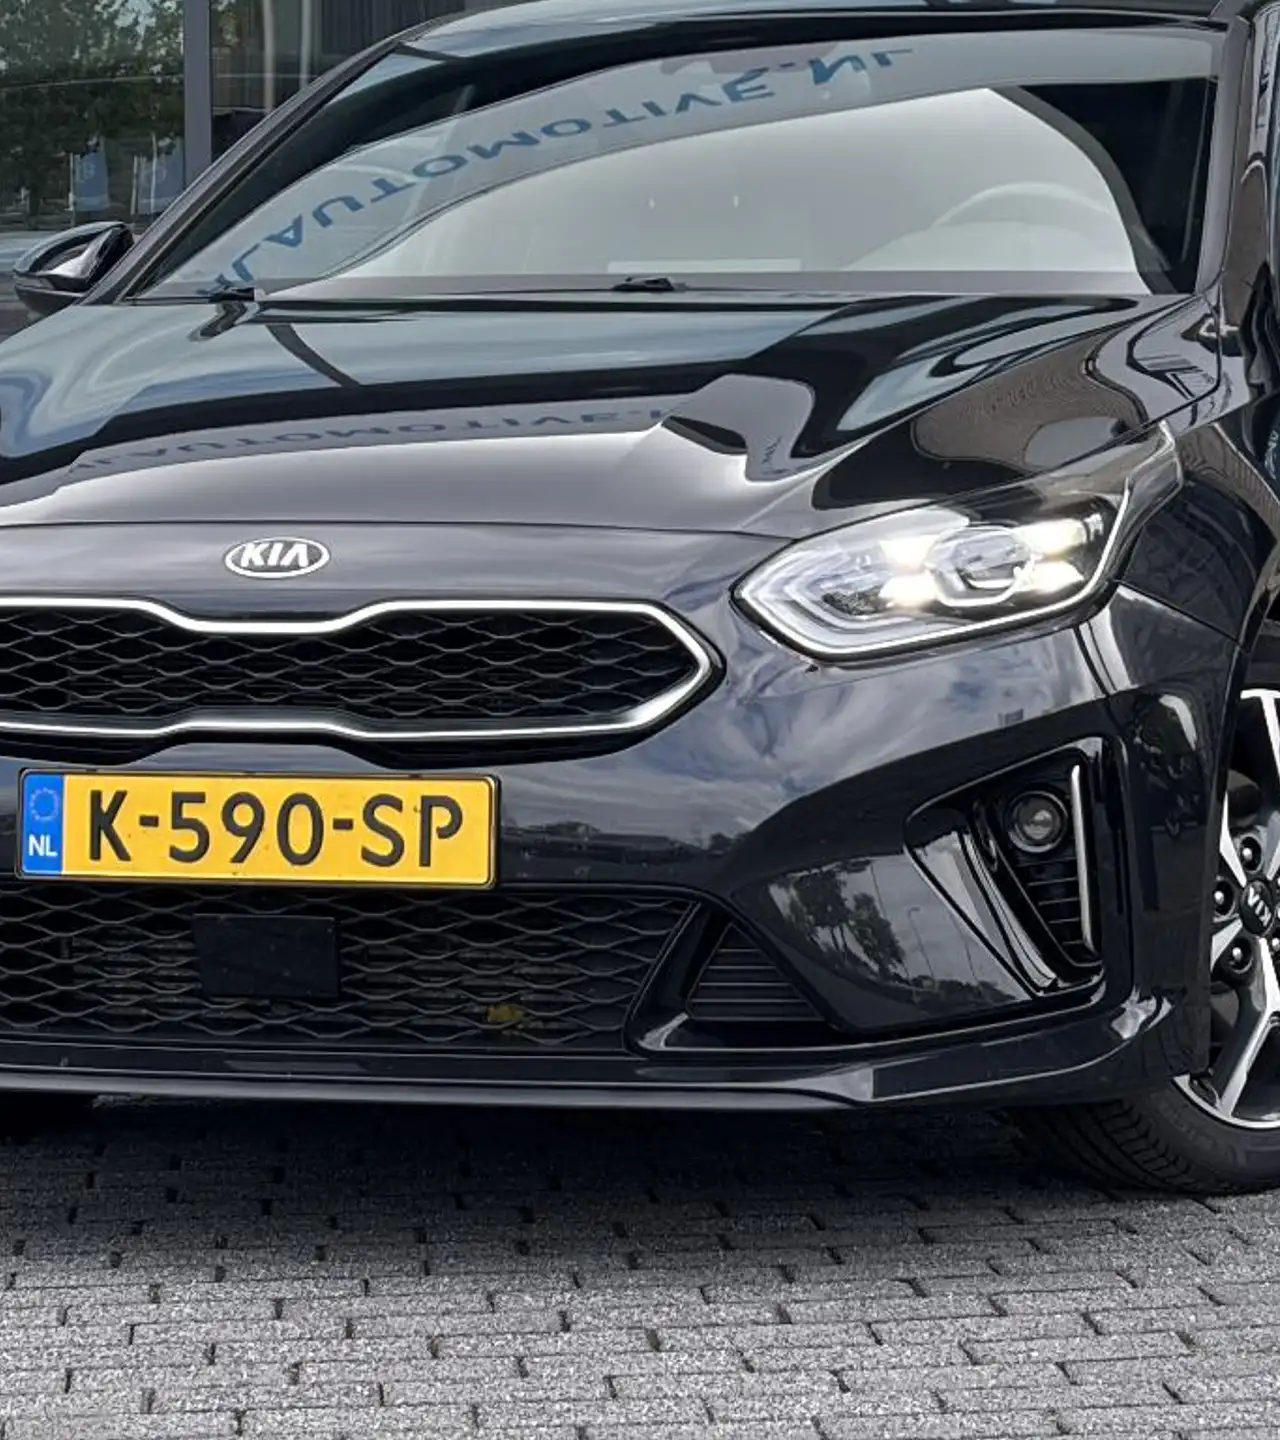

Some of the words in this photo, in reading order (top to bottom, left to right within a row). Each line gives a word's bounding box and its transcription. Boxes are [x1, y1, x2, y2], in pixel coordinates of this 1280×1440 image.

[240, 542, 309, 567] KIA
[28, 834, 58, 857] NL
[89, 789, 464, 868] K-590-SP
